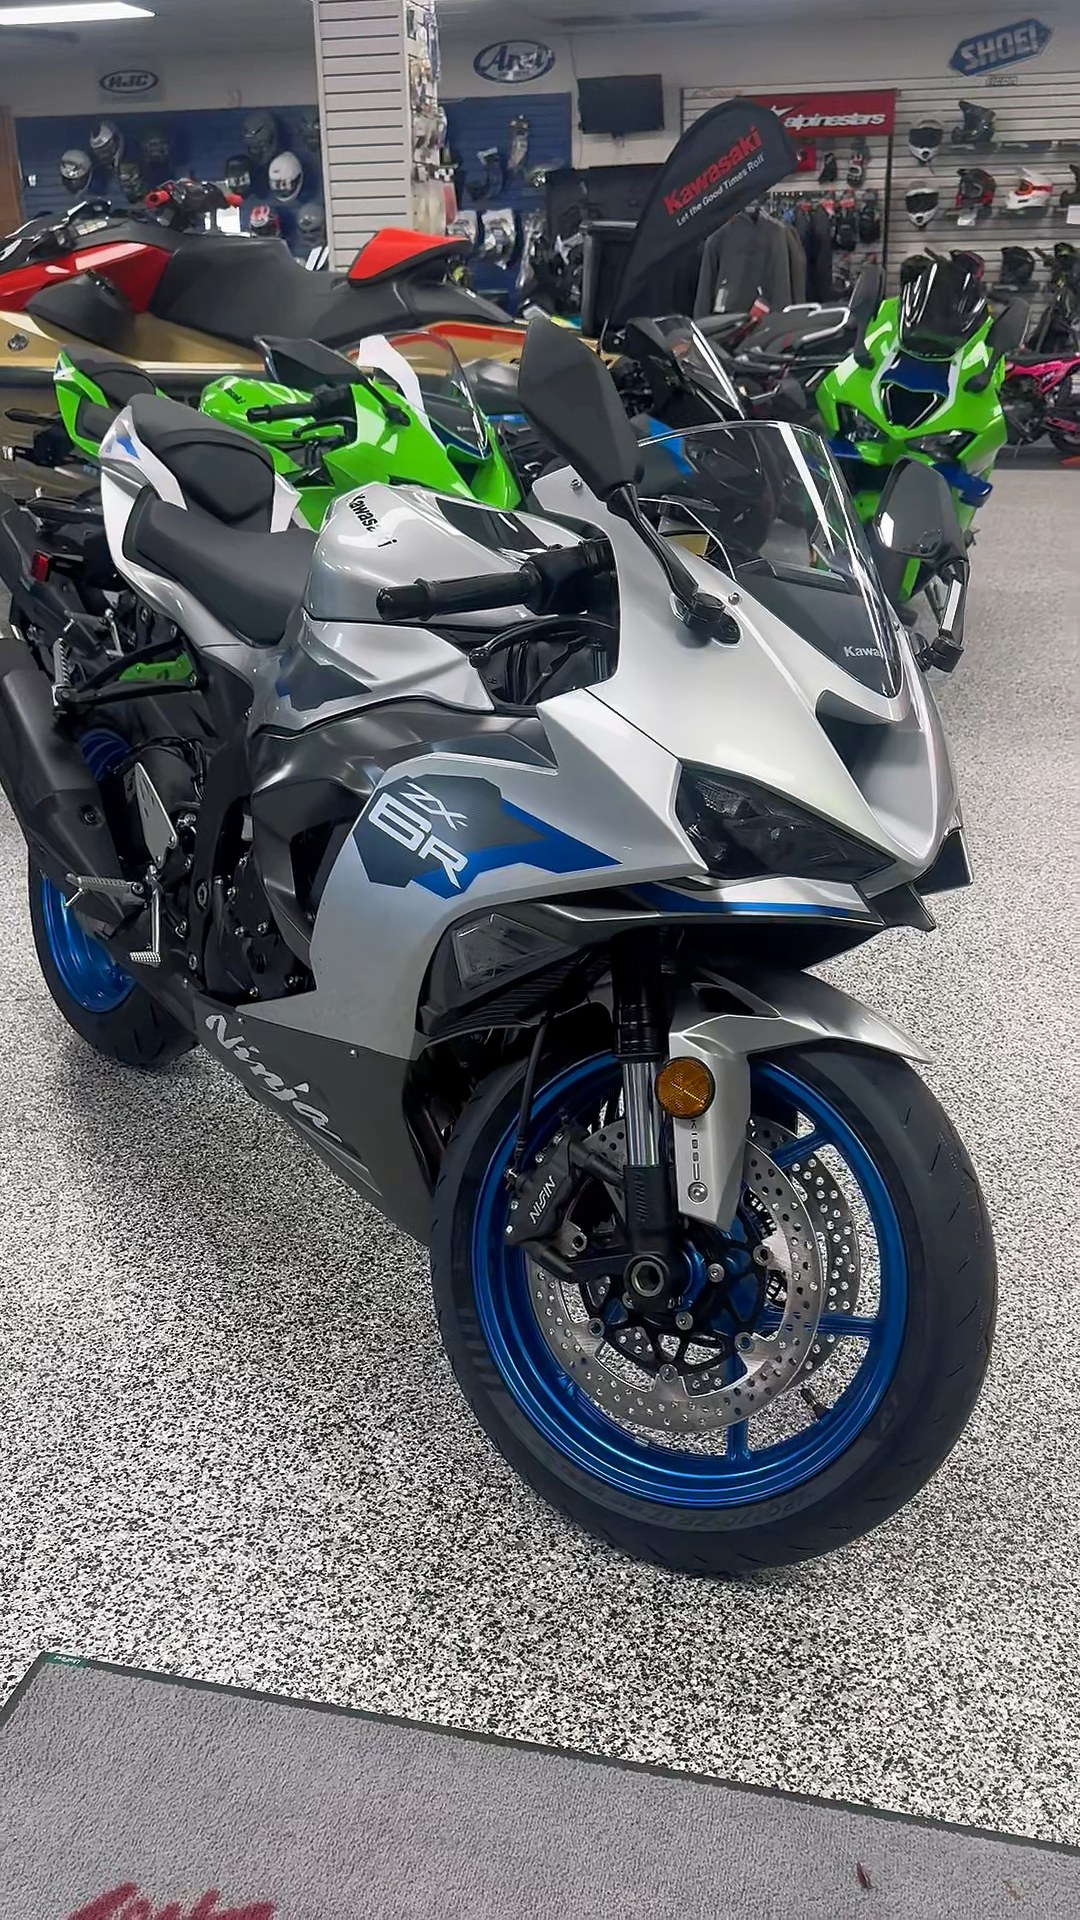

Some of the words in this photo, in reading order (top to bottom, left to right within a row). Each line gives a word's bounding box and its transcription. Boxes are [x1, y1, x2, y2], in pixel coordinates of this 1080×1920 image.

[960, 24, 1039, 71] SHOEI
[784, 113, 886, 131] alpinestars
[663, 125, 762, 217] Kawasaki
[676, 212, 690, 227] Let
[689, 203, 702, 218] the
[702, 186, 724, 207] Good
[723, 168, 748, 190] Times
[746, 153, 765, 172] Roll
[843, 645, 882, 657] Kawa
[369, 793, 468, 889] 6R
[205, 1015, 342, 1142] Ninja
